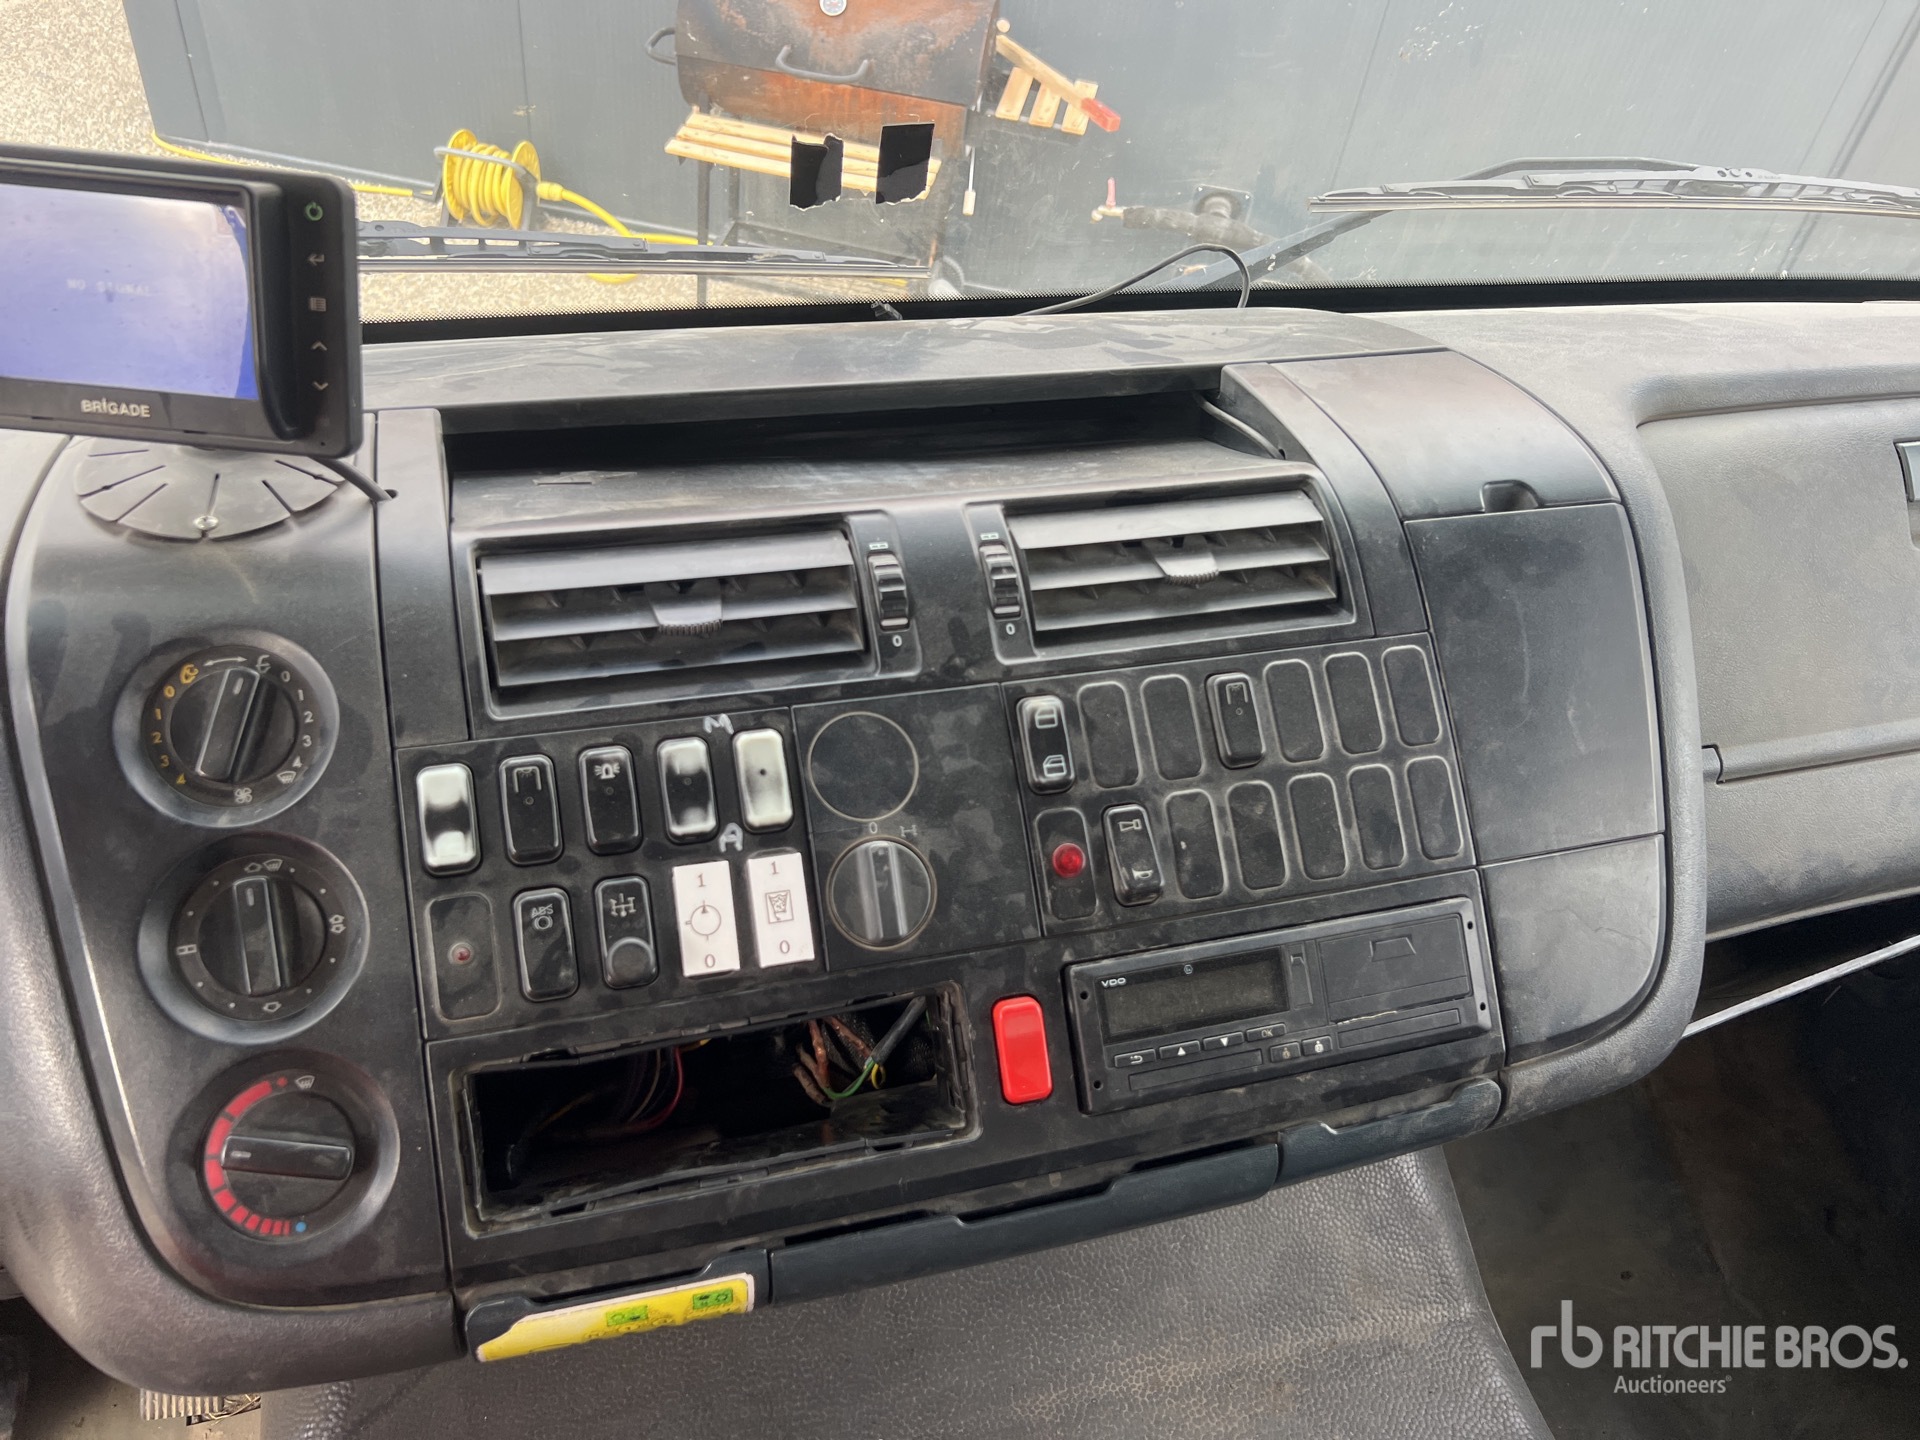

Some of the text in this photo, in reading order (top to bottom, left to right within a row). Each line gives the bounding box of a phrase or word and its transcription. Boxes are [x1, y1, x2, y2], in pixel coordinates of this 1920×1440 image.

[304, 711, 314, 724] 2
[703, 713, 735, 735] M
[152, 732, 163, 744] 2
[303, 735, 312, 747] 3
[160, 755, 170, 767] 3
[292, 756, 303, 767] 4
[176, 774, 187, 785] 4
[718, 822, 744, 852] A
[771, 861, 779, 875] 1
[698, 873, 706, 888] 1
[531, 904, 554, 918] ABS
[1101, 977, 1126, 988] VDO
[1261, 1028, 1274, 1038] OK
